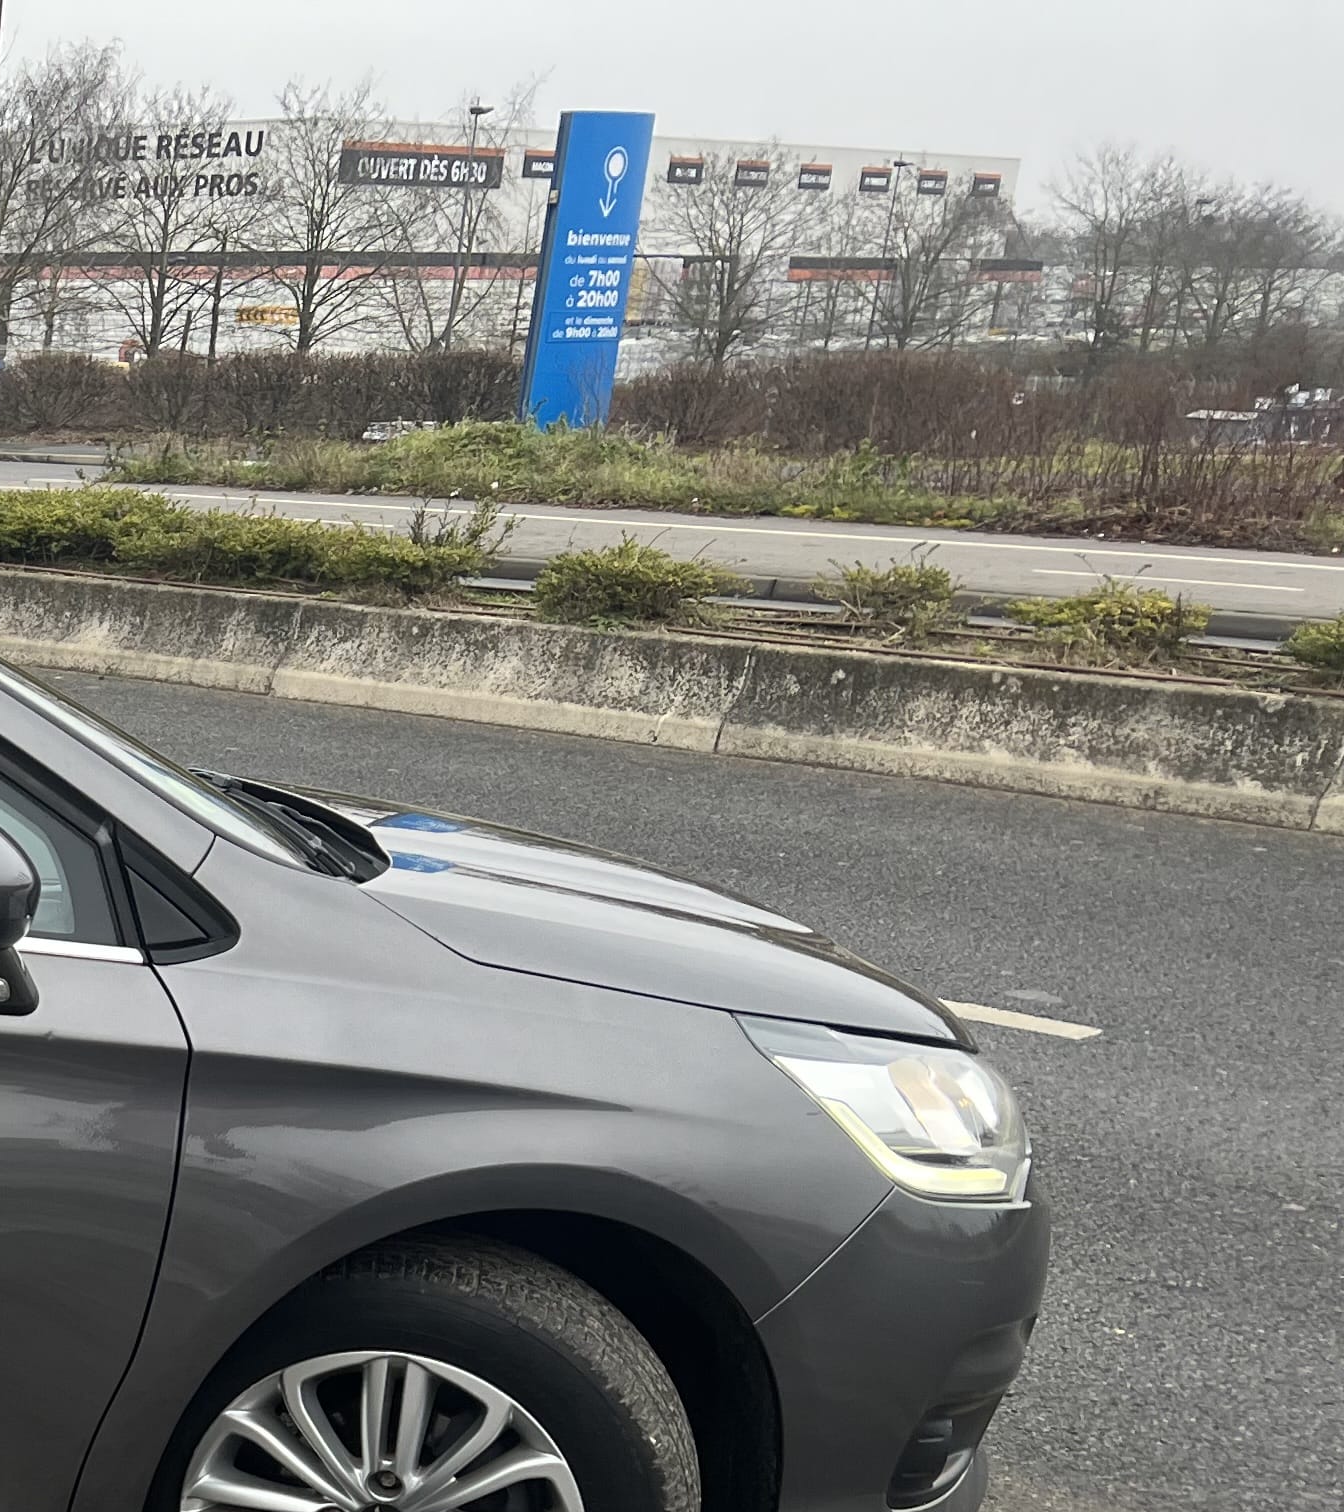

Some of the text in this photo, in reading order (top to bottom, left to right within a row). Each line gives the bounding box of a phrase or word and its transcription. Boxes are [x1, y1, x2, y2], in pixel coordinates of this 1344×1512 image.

[156, 127, 264, 160] RÉSEAU
[357, 154, 487, 183] OUVERT DÈS 6H30
[193, 172, 259, 197] PROS
[567, 228, 631, 247] bienvenue
[569, 269, 621, 288] de 7h00
[576, 289, 619, 308] 20h00
